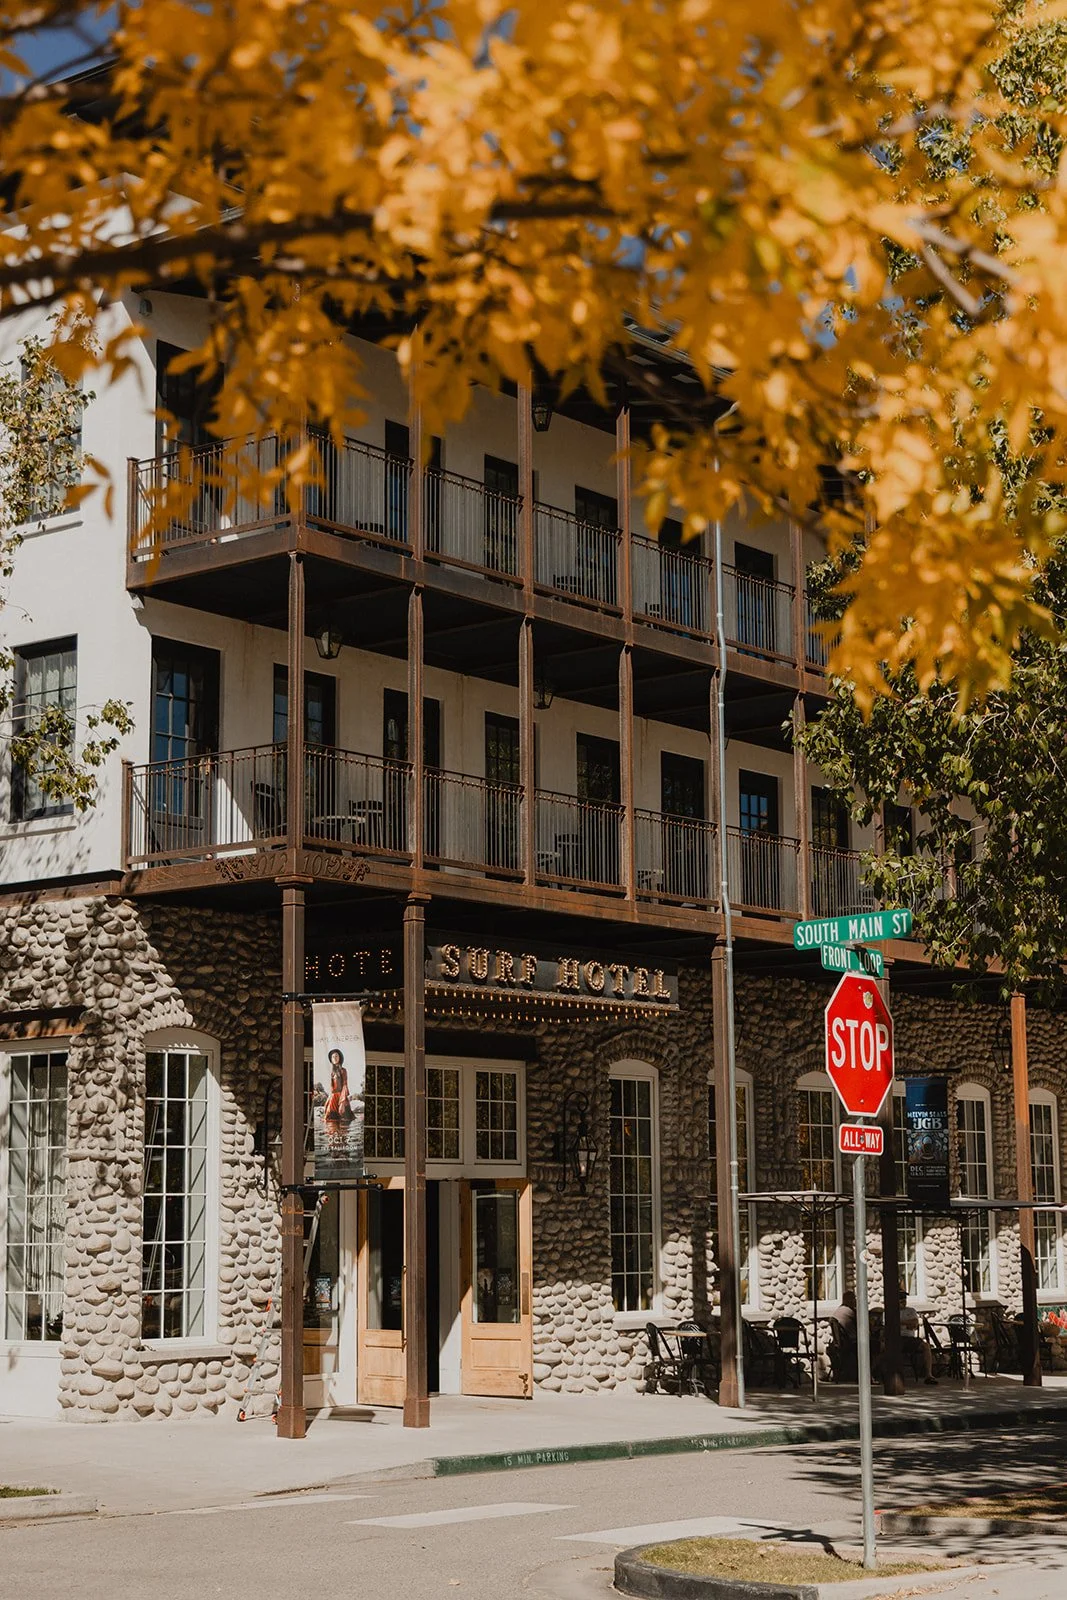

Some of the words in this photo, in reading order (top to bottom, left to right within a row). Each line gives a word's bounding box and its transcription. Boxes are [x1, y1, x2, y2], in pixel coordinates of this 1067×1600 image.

[796, 921, 839, 947] SOUTH
[848, 915, 883, 941] MAIN
[892, 911, 909, 935] ST
[441, 943, 538, 986] SURF
[557, 955, 672, 999] HOTEL
[822, 944, 852, 970] FRONT
[859, 950, 882, 974] LOOP
[831, 1016, 890, 1072] STOP
[913, 1118, 942, 1130] JGB
[843, 1130, 861, 1148] ALL
[865, 1132, 881, 1150] WAY
[503, 1455, 513, 1467] 15
[536, 1451, 570, 1464] PARKING
